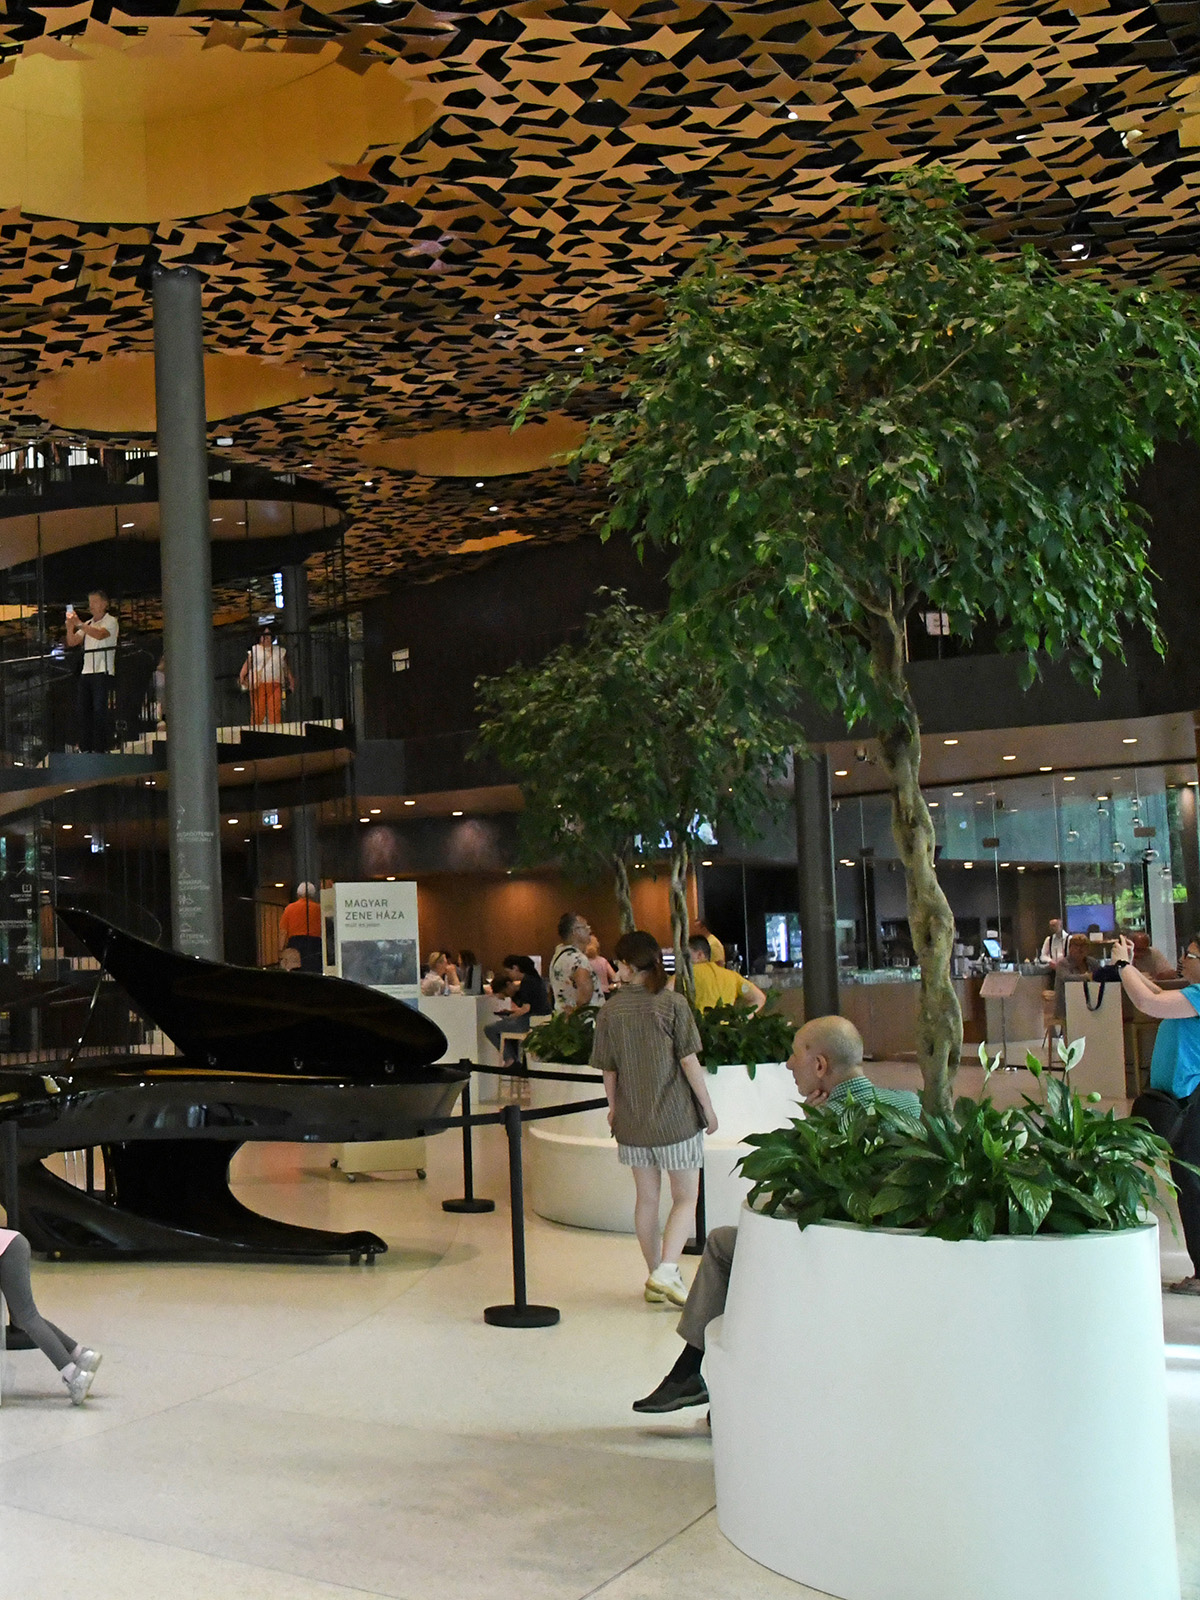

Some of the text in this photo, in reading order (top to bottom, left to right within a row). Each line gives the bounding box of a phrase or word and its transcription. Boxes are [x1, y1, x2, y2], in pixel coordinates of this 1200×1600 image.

[344, 898, 389, 908] MAGYAR
[345, 909, 405, 920] ZENE HÁZA
